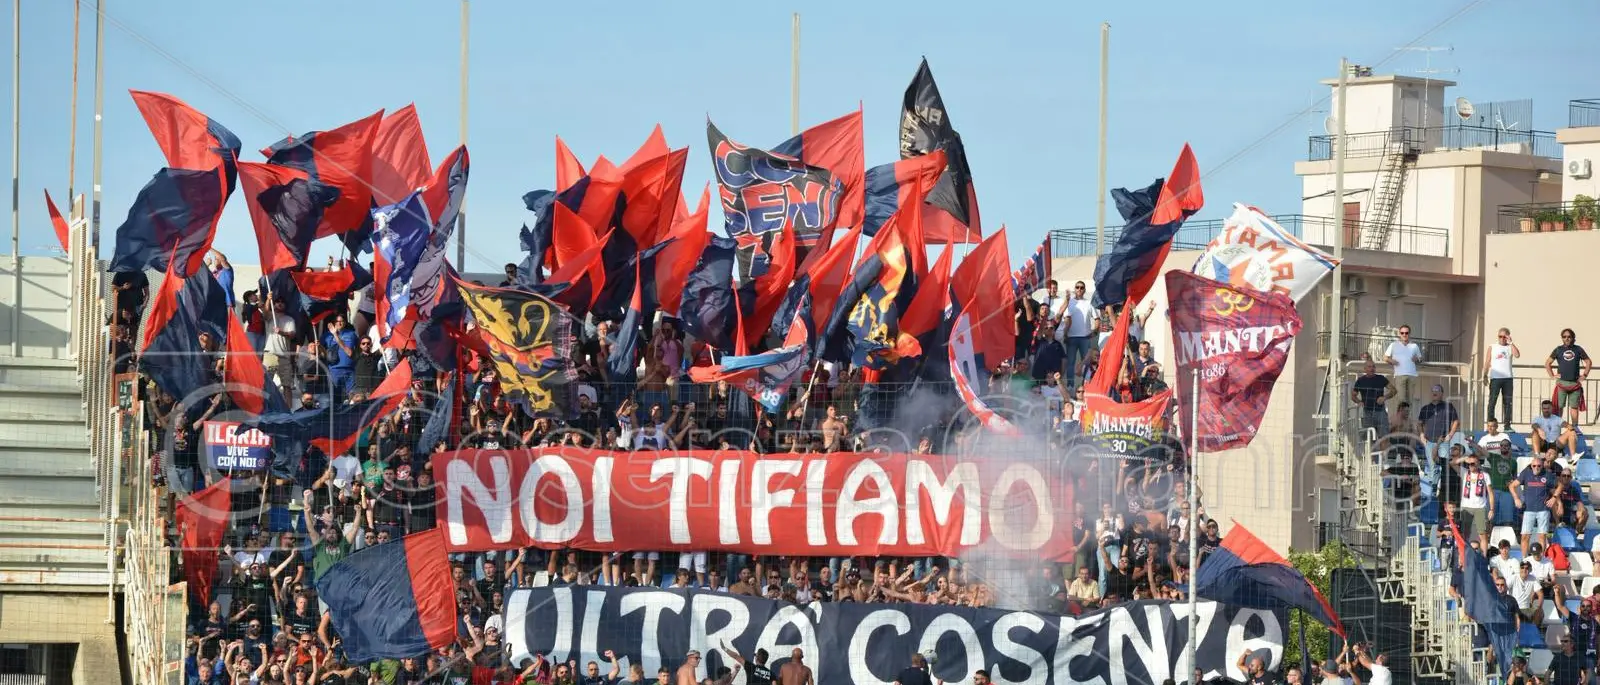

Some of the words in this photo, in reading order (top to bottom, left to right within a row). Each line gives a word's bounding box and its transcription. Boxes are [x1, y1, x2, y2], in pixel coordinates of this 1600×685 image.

[226, 446, 249, 457] VIVE
[1111, 439, 1127, 453] 30
[217, 456, 237, 467] CON
[239, 457, 258, 468] NOI
[446, 454, 615, 547] NOI
[650, 456, 1055, 551] TIFIAMO
[848, 600, 1285, 685] COSENZA
